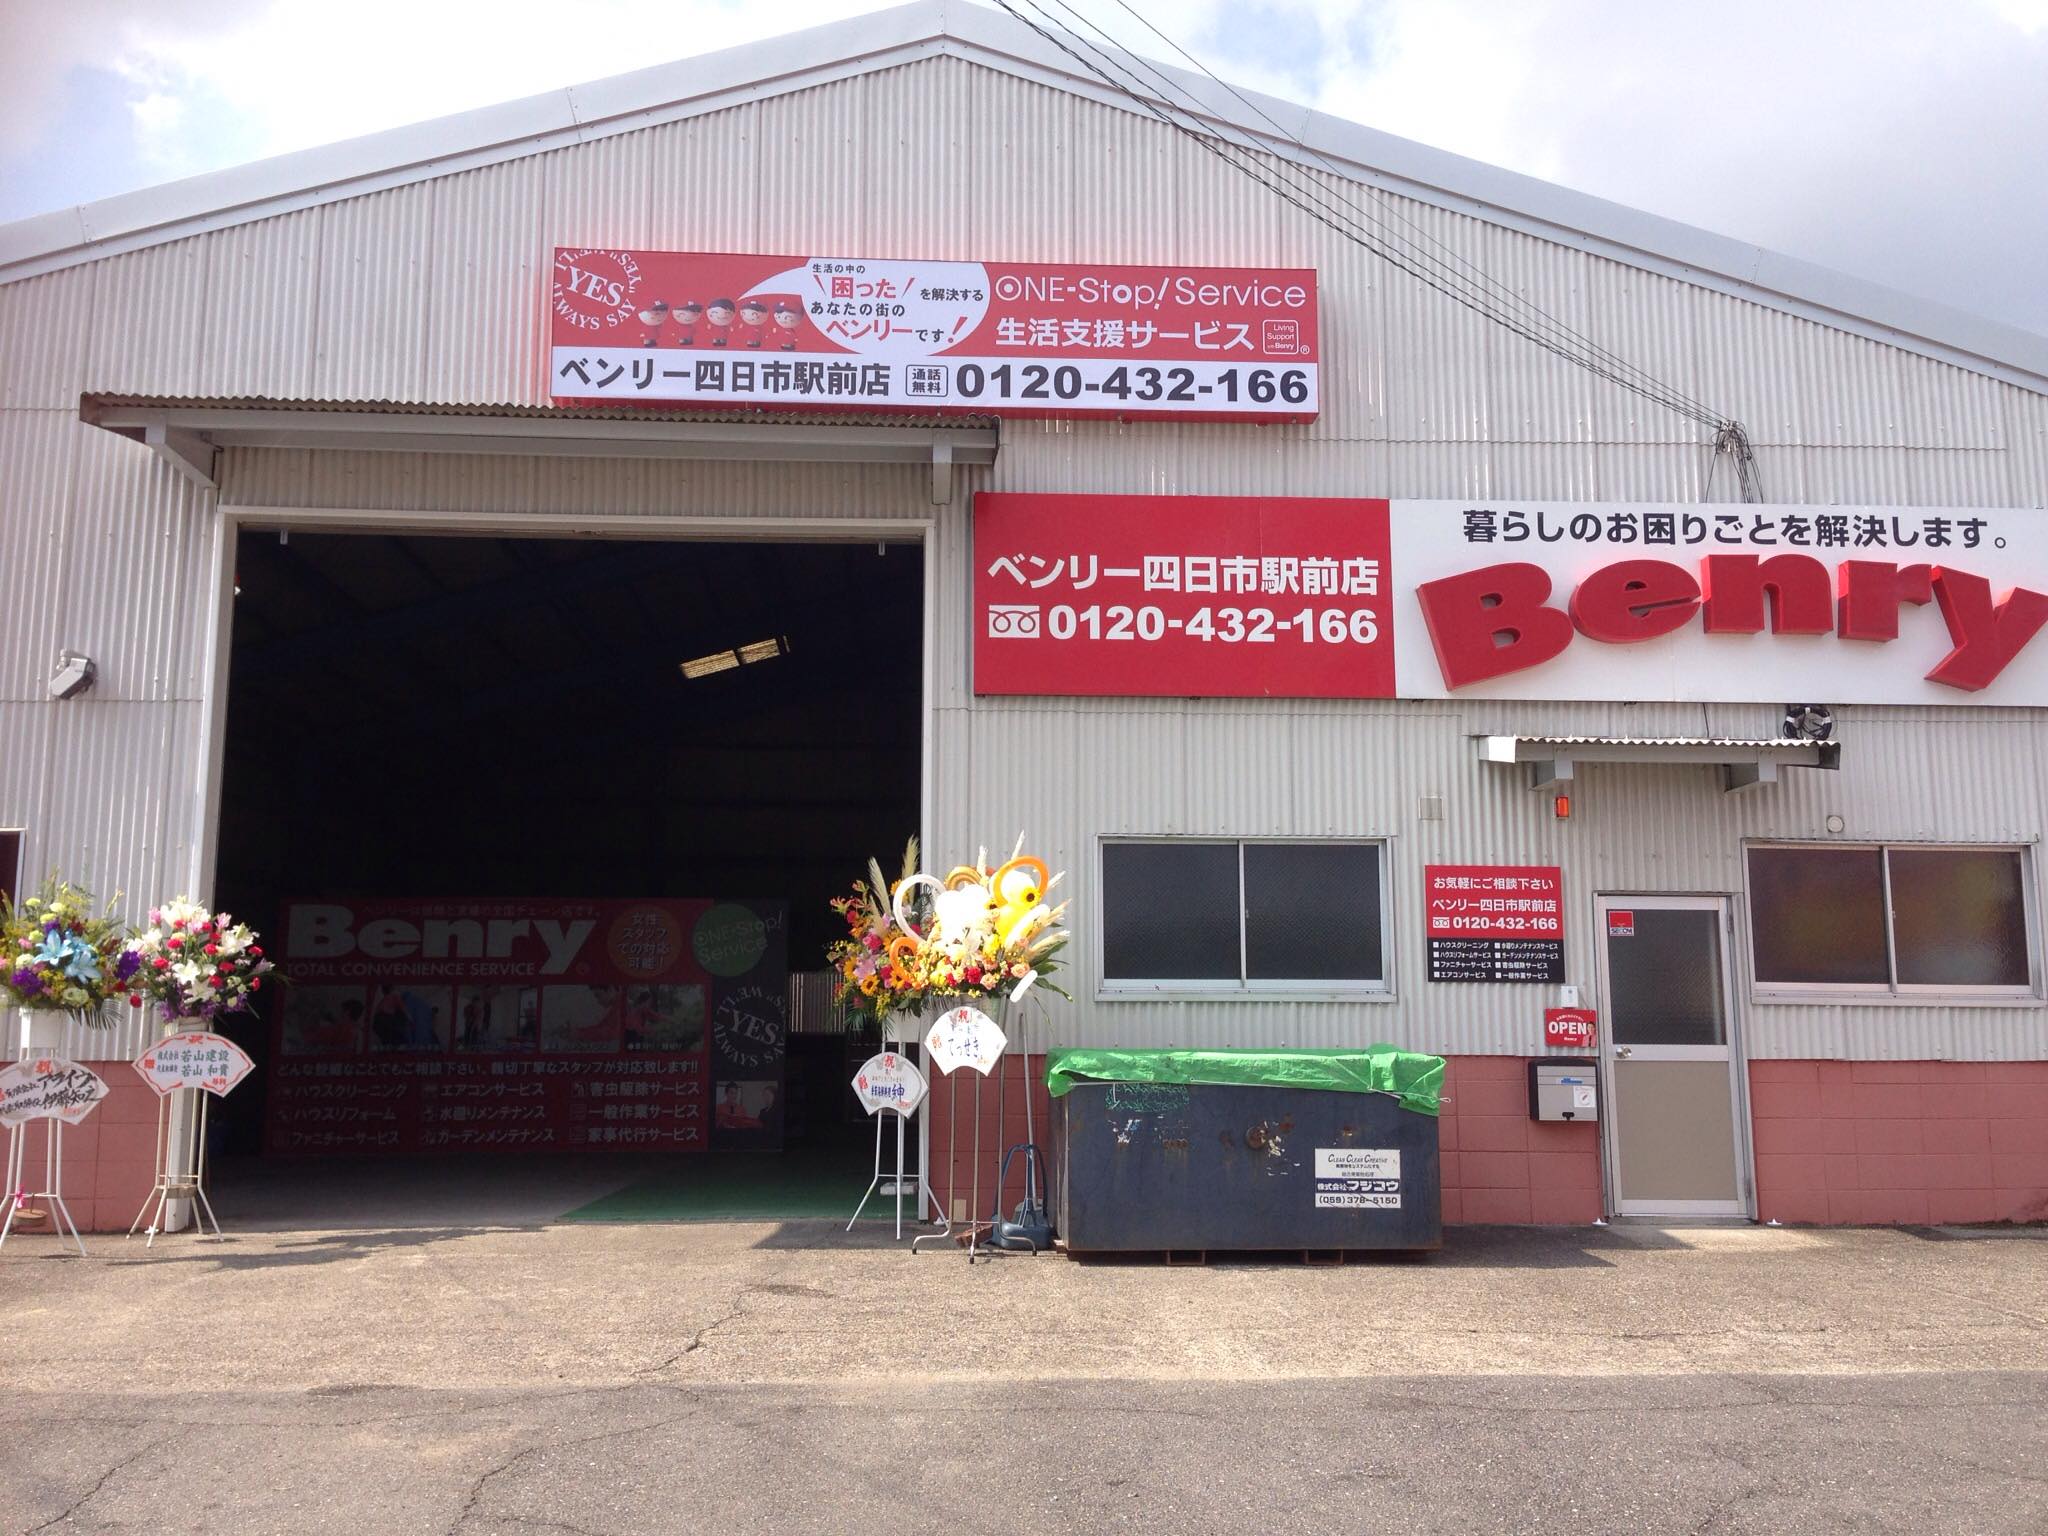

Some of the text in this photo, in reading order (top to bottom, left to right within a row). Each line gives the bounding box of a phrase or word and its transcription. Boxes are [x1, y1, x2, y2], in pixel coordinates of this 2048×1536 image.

[812, 263, 866, 274] 生活の中の
[567, 265, 625, 307] YES
[831, 276, 984, 302] 困った を解決する
[995, 275, 1306, 310] ONE-Stop! Service
[606, 298, 637, 328] SAY
[810, 301, 905, 317] あなたの街の
[995, 317, 1255, 351] 生活支援サービス
[1273, 323, 1295, 332] Living
[1267, 332, 1295, 341] Support
[560, 358, 891, 396] ベンリー四日市駅前店
[912, 368, 941, 381] 通話
[912, 381, 941, 393] 無料
[956, 363, 1308, 404] 0120-432-166
[1463, 509, 2008, 549] 暮らしのお困りごとを解決します。
[987, 552, 1380, 596] ベンリー四日市駅前店
[1047, 604, 1379, 644] 0120-432-166
[1416, 553, 2048, 692] Benry
[1433, 876, 1554, 890] お気軽にご相談下さい
[1432, 898, 1557, 912] ベンリー四日市駅前店
[1452, 916, 1558, 930] 0120-432-166
[286, 903, 598, 975] Benry
[286, 961, 536, 976] TOTAL CONVENIENCE SERVICE
[730, 1008, 779, 1045] YES
[1548, 1020, 1587, 1035] OPEN
[294, 1081, 409, 1098] ハウスクリーニング
[439, 1082, 545, 1098] エアコンサービス
[293, 1104, 399, 1121] ハウスリフォーム
[437, 1128, 556, 1145] ガーデンメンテナンス
